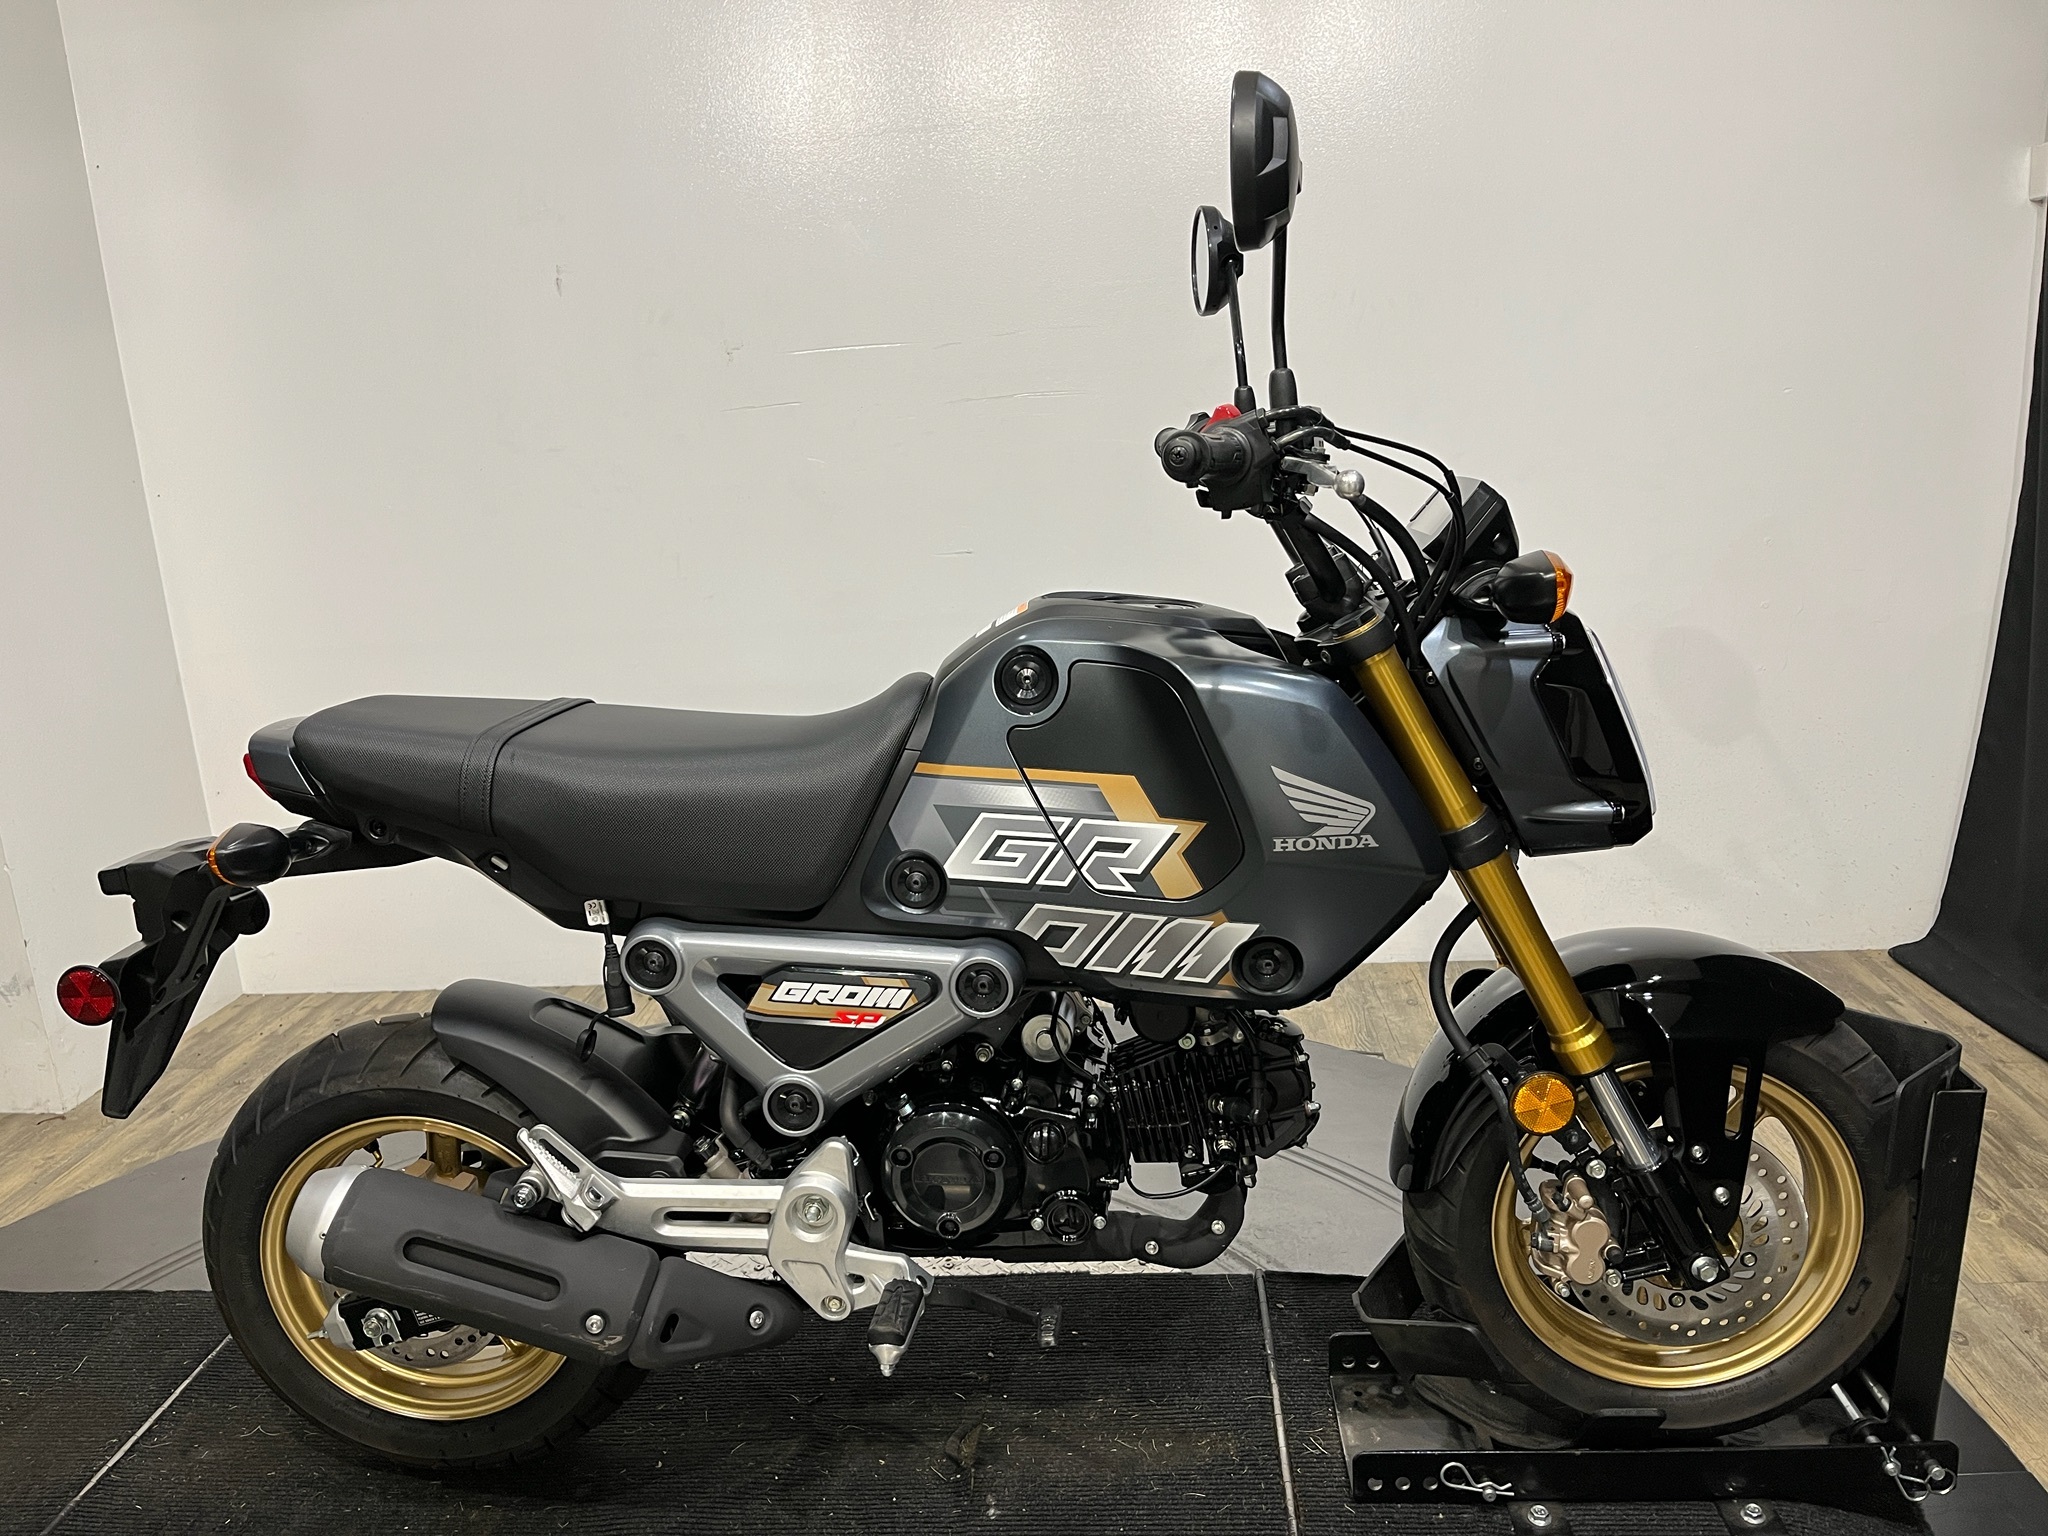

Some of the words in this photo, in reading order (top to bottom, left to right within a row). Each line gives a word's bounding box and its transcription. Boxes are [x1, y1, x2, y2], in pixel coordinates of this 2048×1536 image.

[1273, 834, 1380, 852] HONDA
[768, 980, 914, 1010] GROM
[829, 1011, 886, 1026] SP
